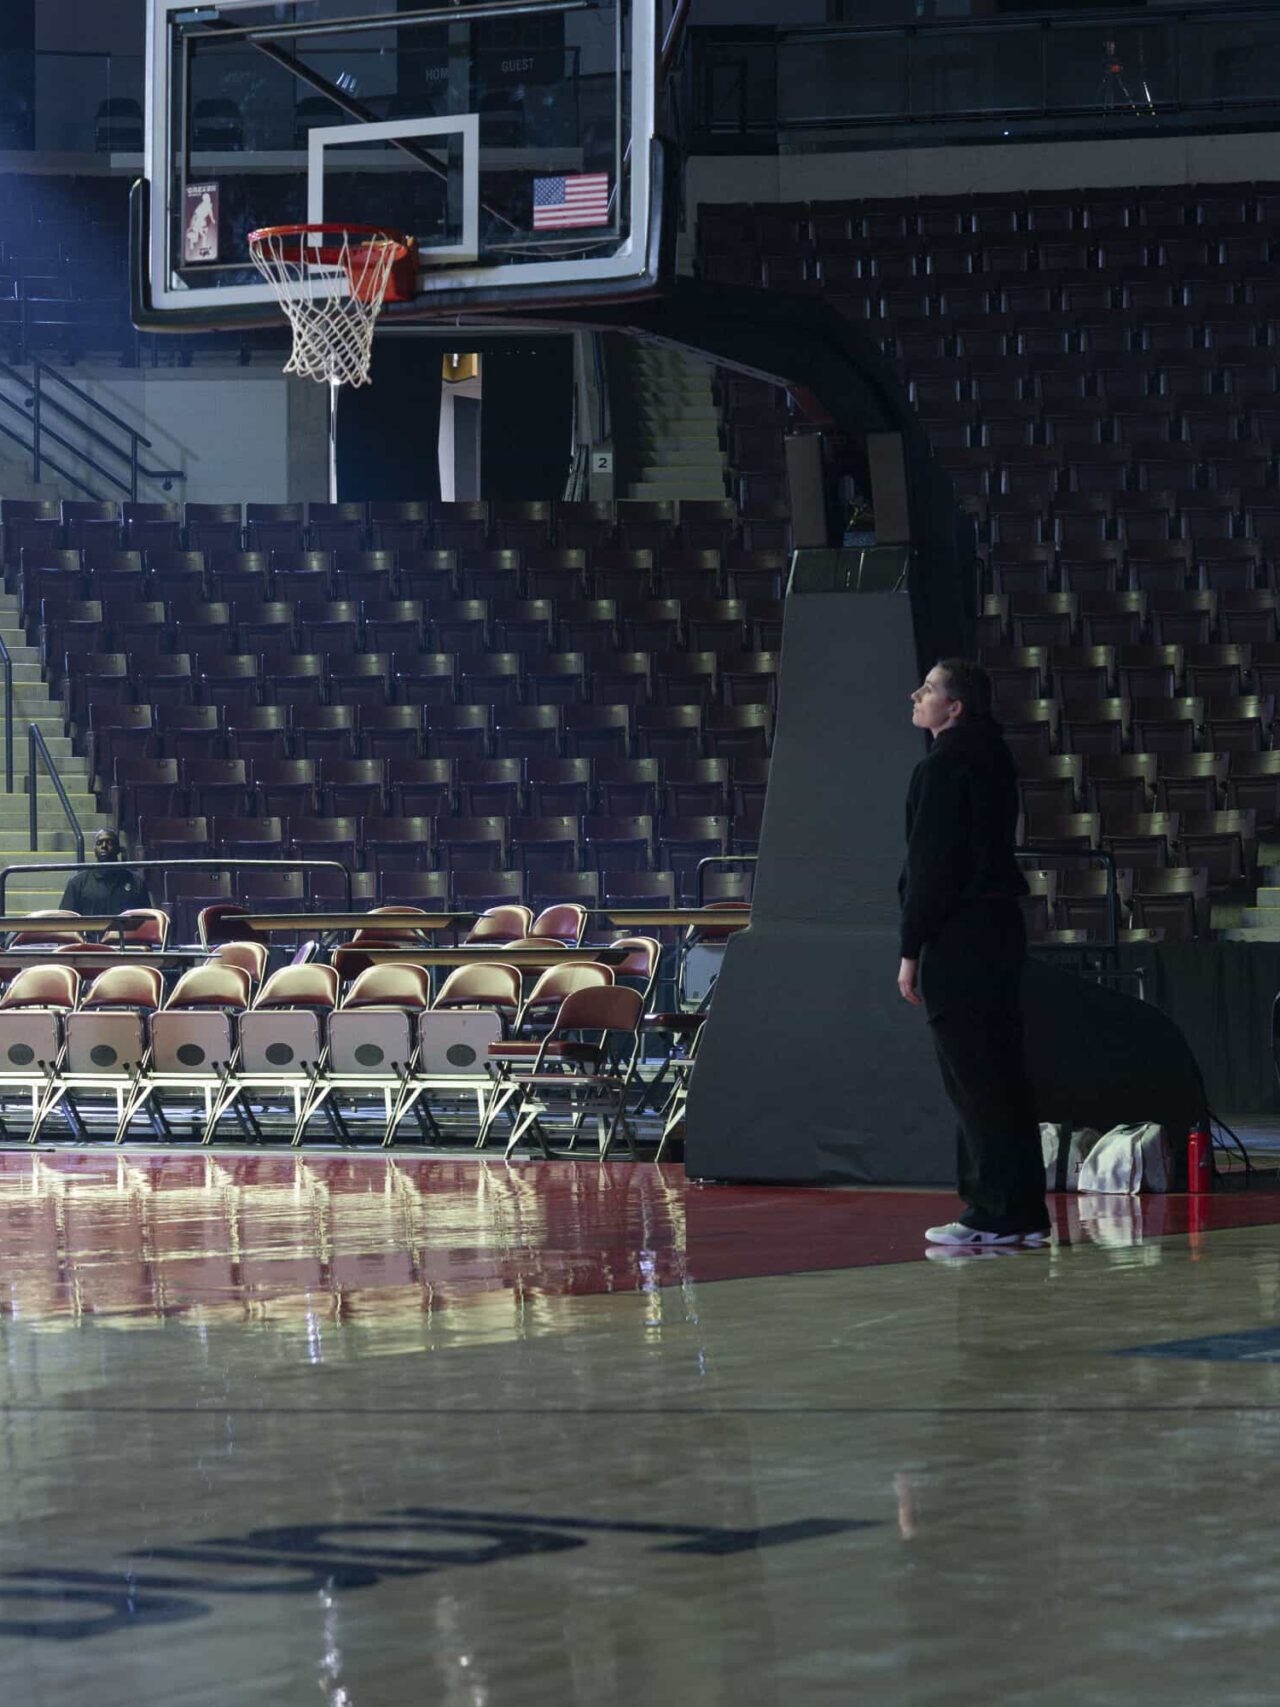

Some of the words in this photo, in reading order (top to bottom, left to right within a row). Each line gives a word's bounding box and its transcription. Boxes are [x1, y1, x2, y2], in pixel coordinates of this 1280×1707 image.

[501, 58, 535, 73] GUEST
[425, 67, 449, 81] HOM
[598, 457, 608, 468] 2
